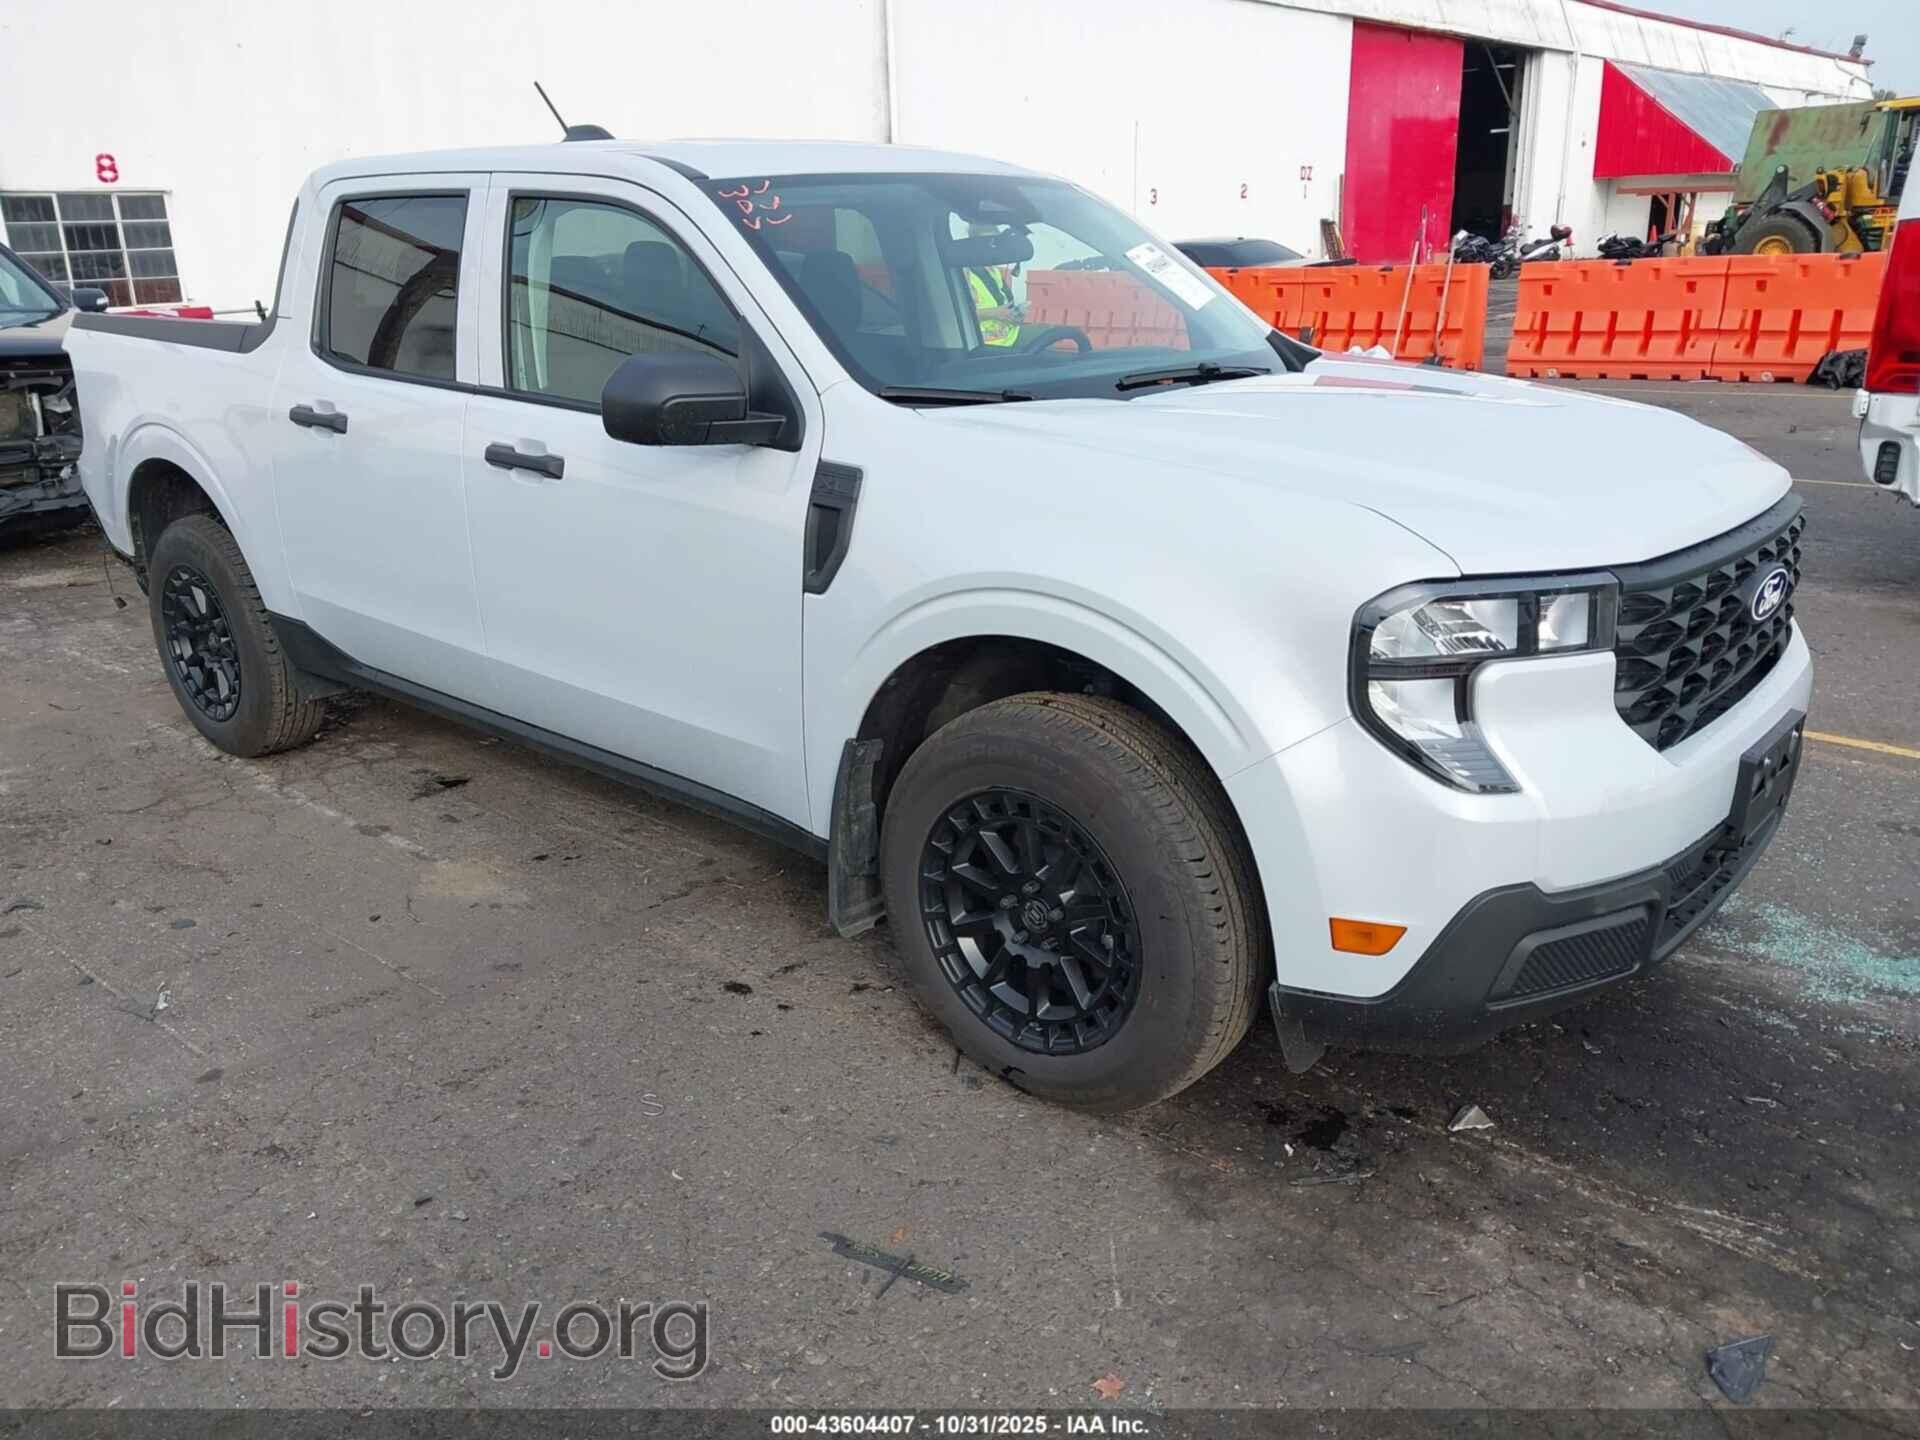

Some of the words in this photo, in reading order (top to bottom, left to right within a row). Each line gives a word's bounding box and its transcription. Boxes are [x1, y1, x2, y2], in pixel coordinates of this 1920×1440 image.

[96, 153, 119, 183] 8
[1150, 188, 1157, 205] 3
[1240, 183, 1248, 199] 2
